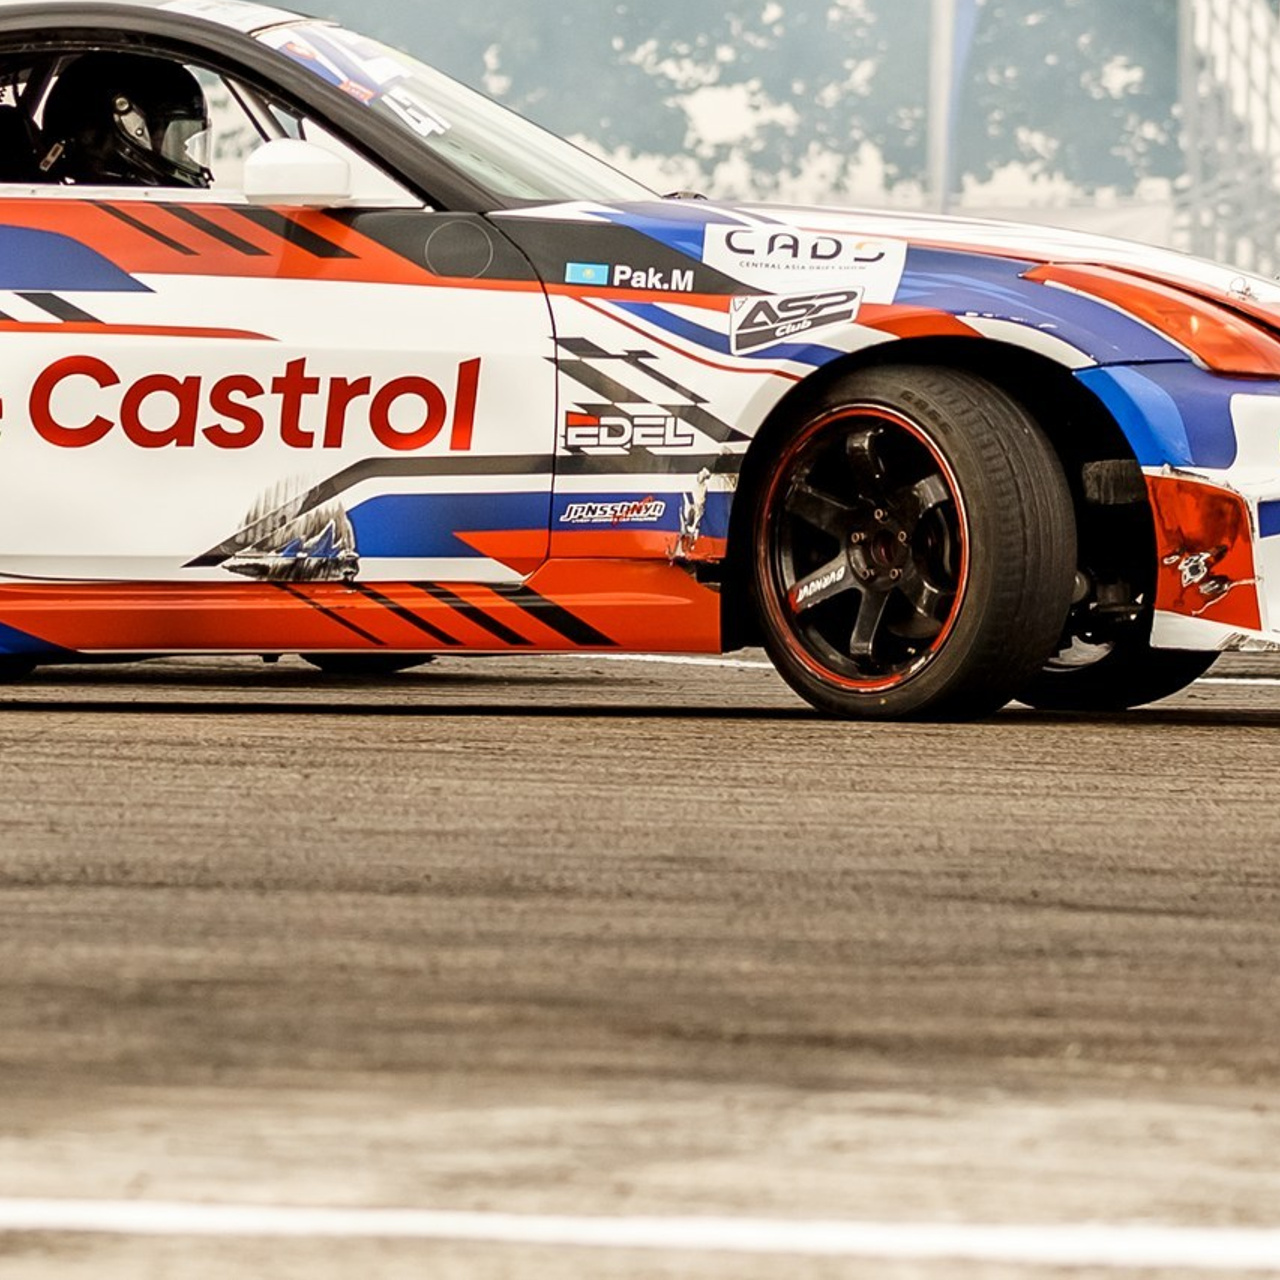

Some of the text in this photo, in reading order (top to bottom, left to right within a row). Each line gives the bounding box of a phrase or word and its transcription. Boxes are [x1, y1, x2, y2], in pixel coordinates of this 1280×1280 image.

[725, 229, 885, 263] CADS
[613, 264, 694, 292] Pak.M
[739, 260, 782, 270] CENTRAL
[736, 291, 858, 331] ASP
[775, 318, 813, 338] Club
[28, 354, 481, 451] Castrol
[565, 410, 694, 447] EDEL
